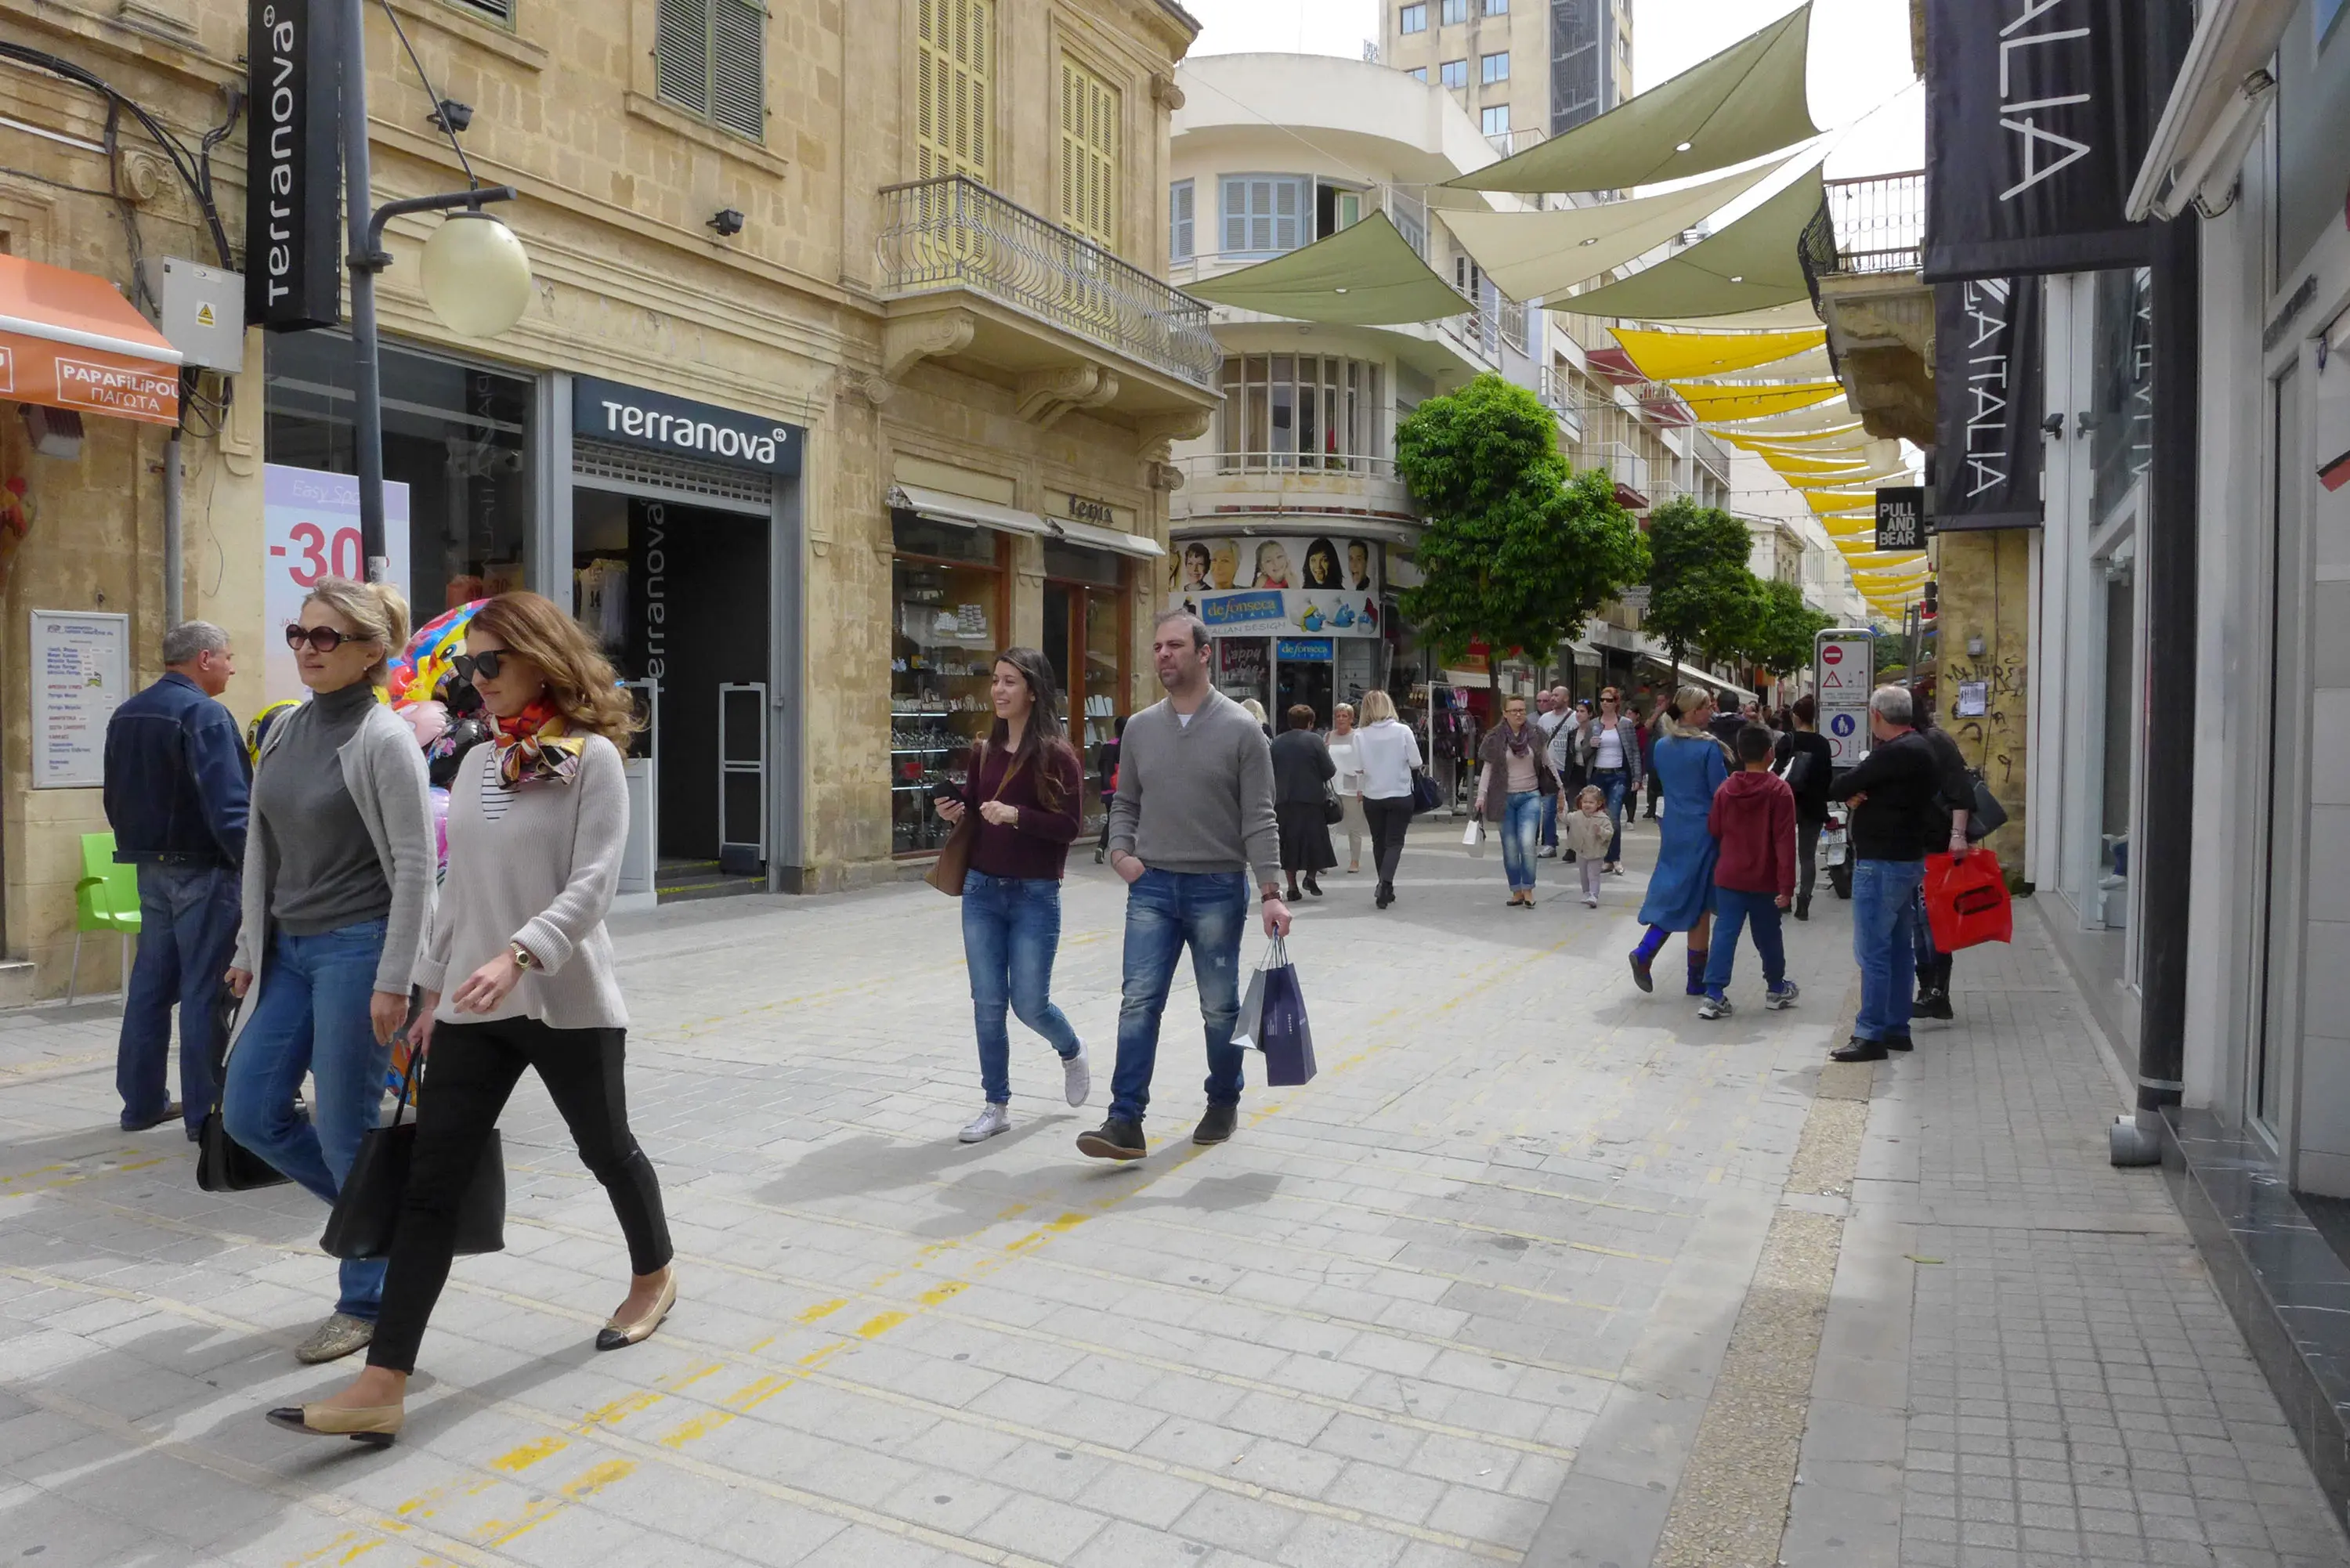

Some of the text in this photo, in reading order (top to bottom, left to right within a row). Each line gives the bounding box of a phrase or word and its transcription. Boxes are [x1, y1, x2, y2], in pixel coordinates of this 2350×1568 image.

[269, 20, 294, 306] Terranova
[91, 387, 161, 411] ΠΑΓΩΤΑ
[602, 401, 776, 464] Terranova
[1966, 355, 2007, 498] ITALIA
[1880, 502, 1916, 517] PULL
[1886, 517, 1916, 531] AND
[1879, 531, 1915, 546] BEAR
[647, 502, 665, 692] erranova
